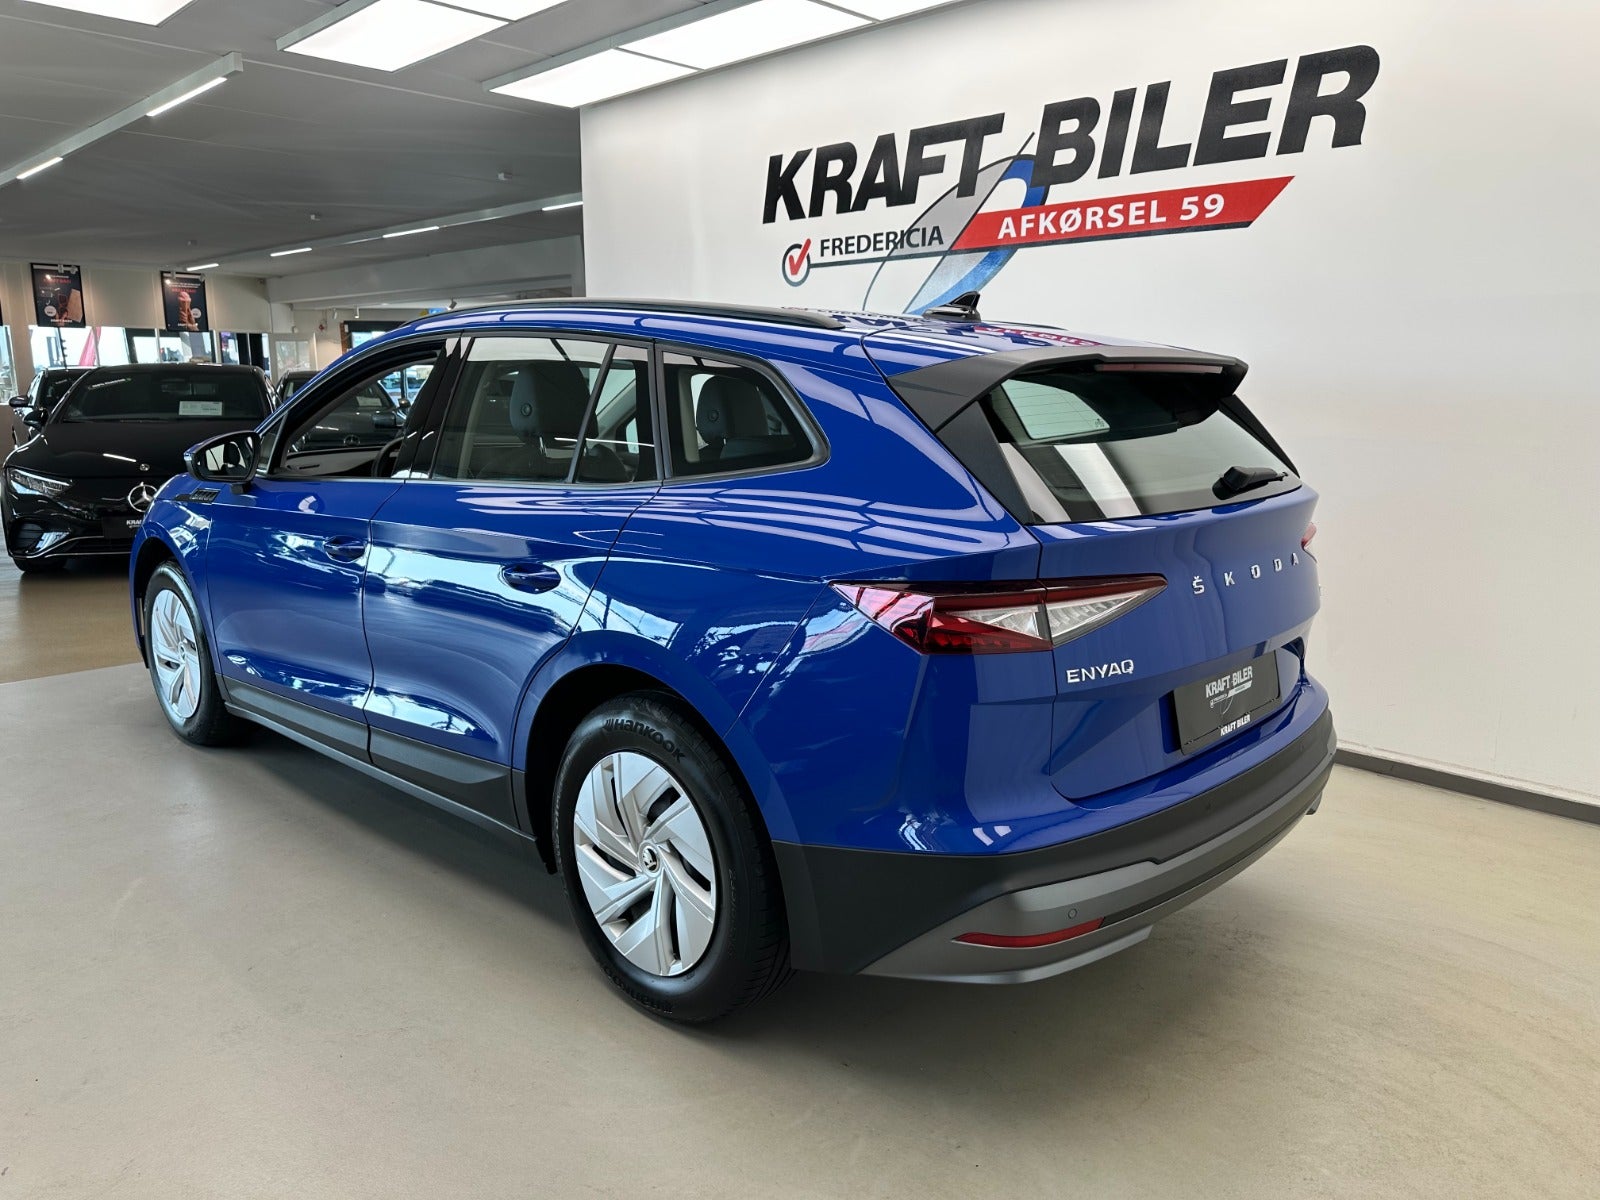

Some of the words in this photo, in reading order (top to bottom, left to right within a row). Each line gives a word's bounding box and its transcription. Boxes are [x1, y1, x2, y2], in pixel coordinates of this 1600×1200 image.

[763, 112, 1005, 224] KRAFT
[1029, 44, 1381, 188] BILER
[997, 199, 1167, 240] AFKØRSEL
[1179, 193, 1225, 221] 59
[820, 225, 944, 257] FREDERICIA
[1192, 552, 1300, 595] ŠKODA
[1066, 659, 1135, 684] ENYAQ
[1205, 675, 1231, 698] KRAFT
[1232, 665, 1253, 687] BILER
[1220, 721, 1236, 737] KRAFT
[1237, 714, 1251, 728] BILER
